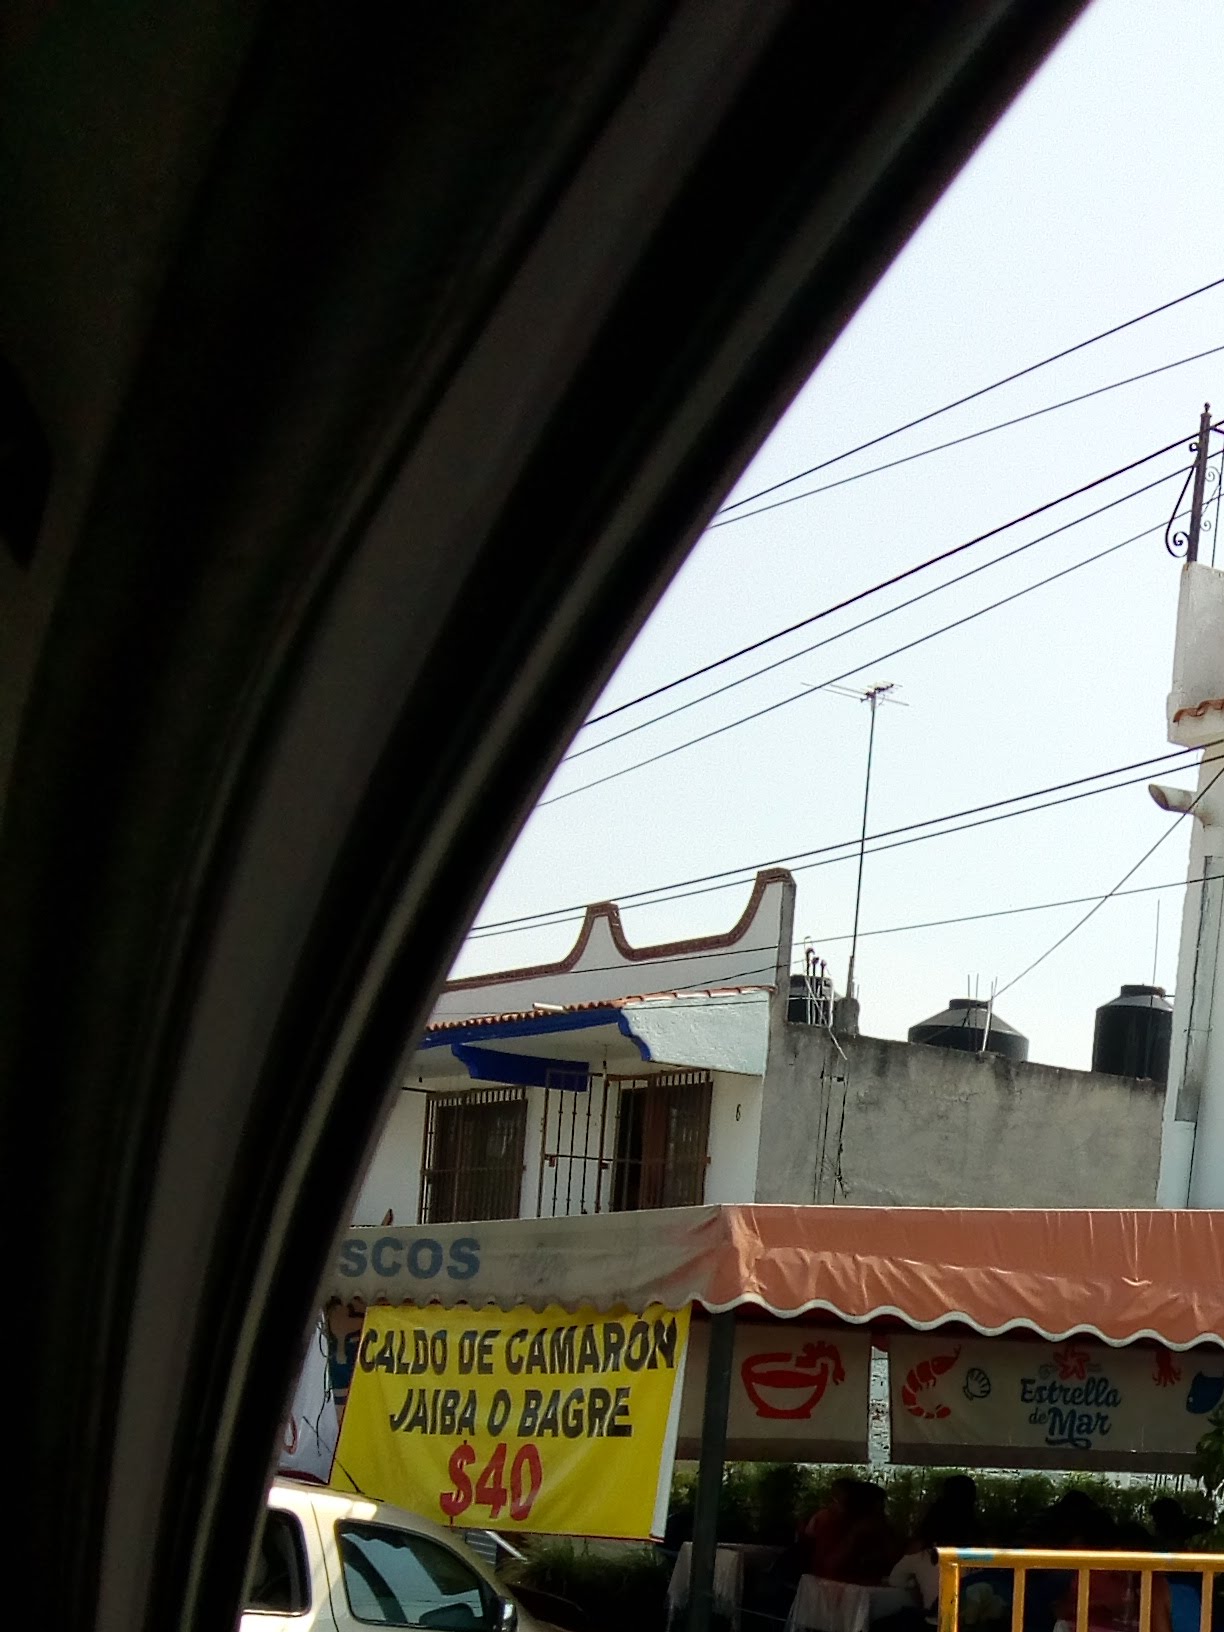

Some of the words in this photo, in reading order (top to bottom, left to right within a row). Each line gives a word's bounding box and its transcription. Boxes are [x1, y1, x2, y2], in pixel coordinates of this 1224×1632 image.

[359, 1328, 448, 1376] CALDO
[458, 1329, 500, 1375] DE
[389, 1388, 477, 1437] JAIBA
[486, 1388, 512, 1438] O
[516, 1386, 633, 1438] BAGRE
[1020, 1376, 1122, 1408] Estrella
[1028, 1406, 1047, 1425] de
[1044, 1406, 1112, 1449] Mar
[439, 1440, 544, 1525] $40
